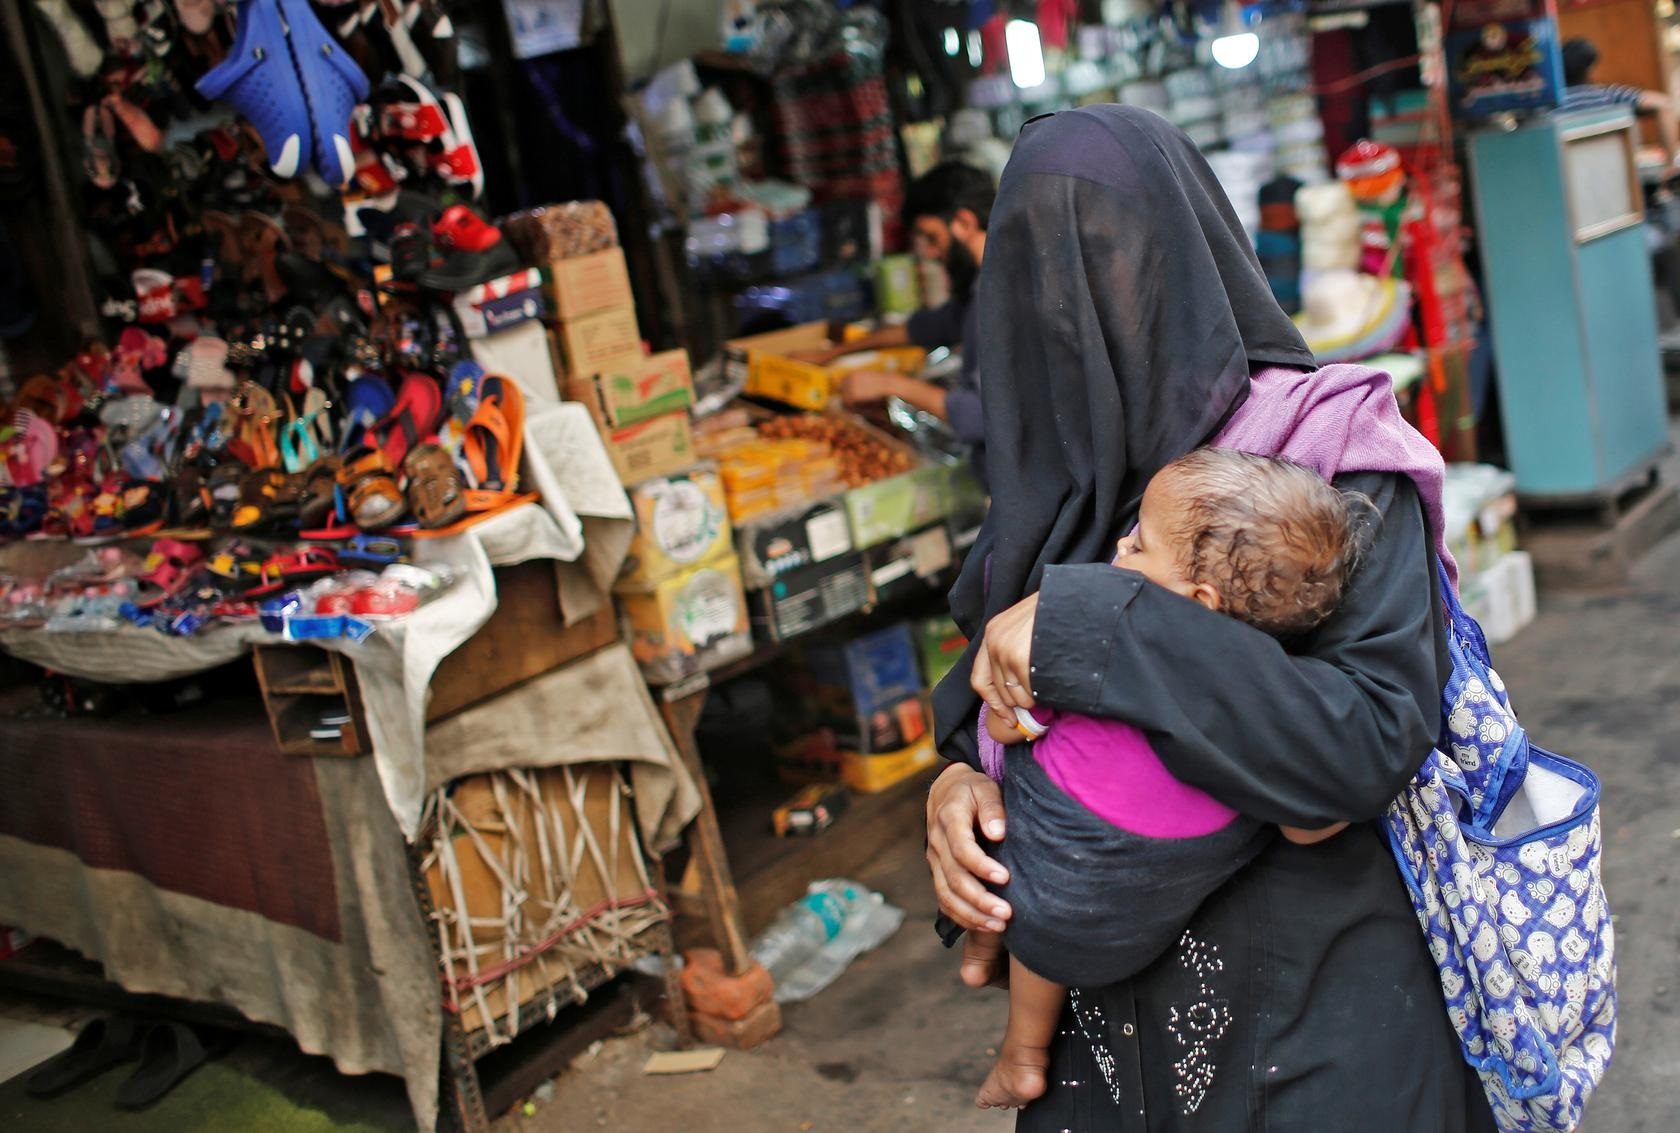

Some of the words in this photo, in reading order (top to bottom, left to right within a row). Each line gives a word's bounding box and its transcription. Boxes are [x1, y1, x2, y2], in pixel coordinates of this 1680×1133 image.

[1460, 758, 1476, 767] friend
[1552, 853, 1560, 872] friend
[1565, 942, 1578, 957] friend
[1513, 954, 1526, 968] friend
[1489, 977, 1504, 993] friend
